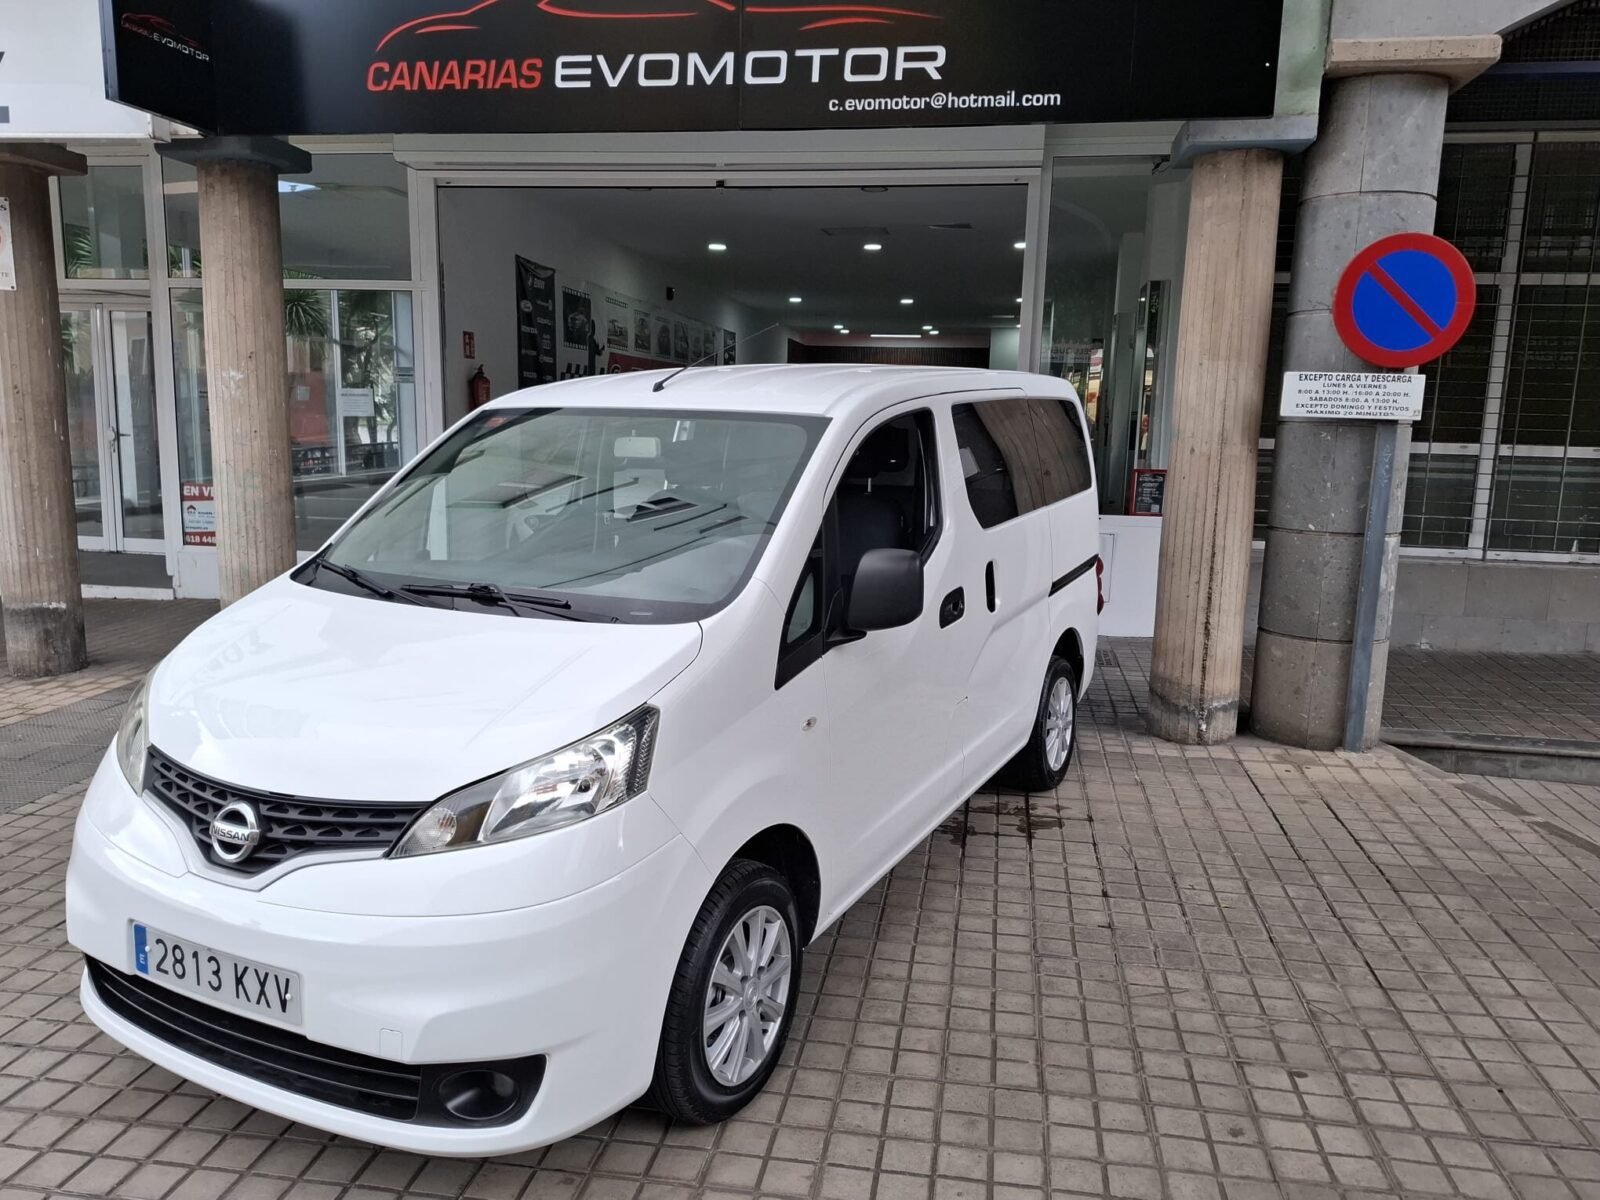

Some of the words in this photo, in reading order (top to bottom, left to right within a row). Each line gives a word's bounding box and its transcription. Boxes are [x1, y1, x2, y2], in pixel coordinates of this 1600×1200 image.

[153, 32, 210, 61] EVOMOTOR
[366, 58, 544, 91] CANARIAS
[554, 45, 947, 88] EVOMOTOR
[828, 90, 1062, 111] c.evomotor@hotmail.com
[1298, 373, 1334, 382] EXCEPTO
[1335, 374, 1362, 383] CARGA
[1371, 375, 1413, 384] DESCARGA
[183, 485, 199, 497] EN
[211, 825, 250, 842] NISSAN
[139, 953, 145, 965] E
[155, 938, 222, 992] 2813
[233, 962, 290, 1013] KXV
